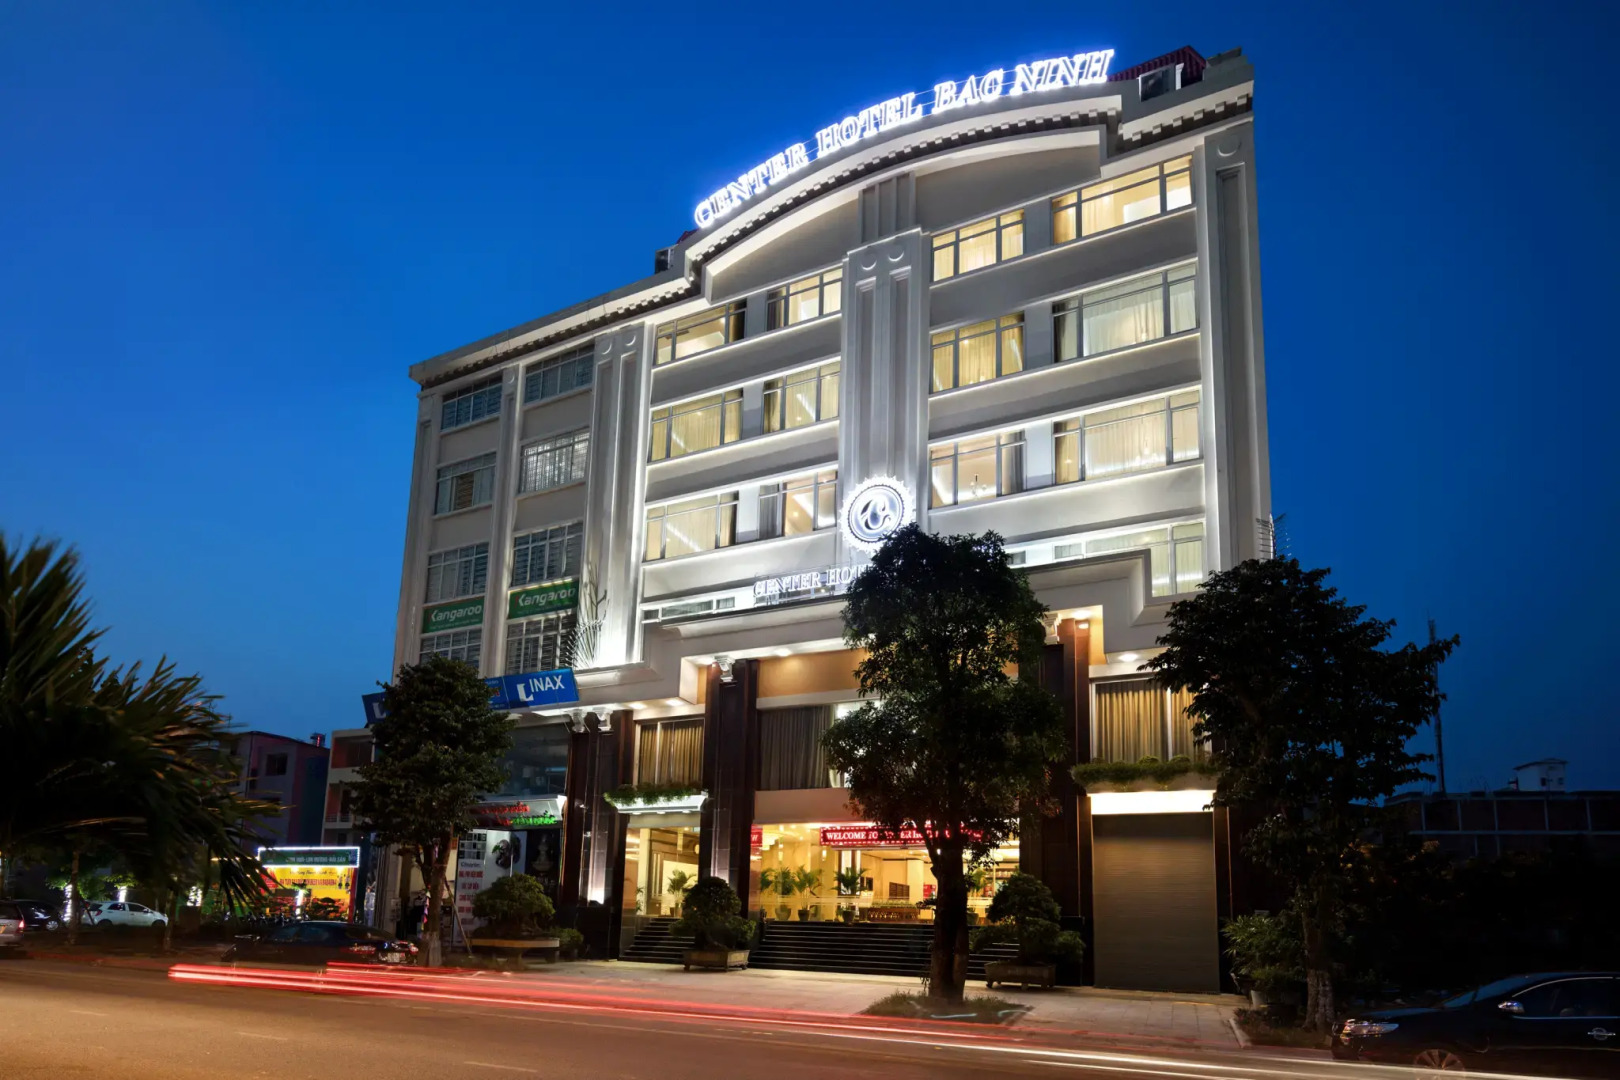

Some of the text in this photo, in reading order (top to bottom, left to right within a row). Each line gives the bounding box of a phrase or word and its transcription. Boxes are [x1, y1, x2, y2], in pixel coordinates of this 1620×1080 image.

[694, 49, 1115, 229] CENTER HOTEL BAC NINH
[753, 571, 822, 597] CENTER
[515, 588, 576, 608] Kangaroo
[428, 604, 482, 622] Kangaroo
[825, 832, 866, 841] WELCOME
[868, 832, 878, 841] TO
